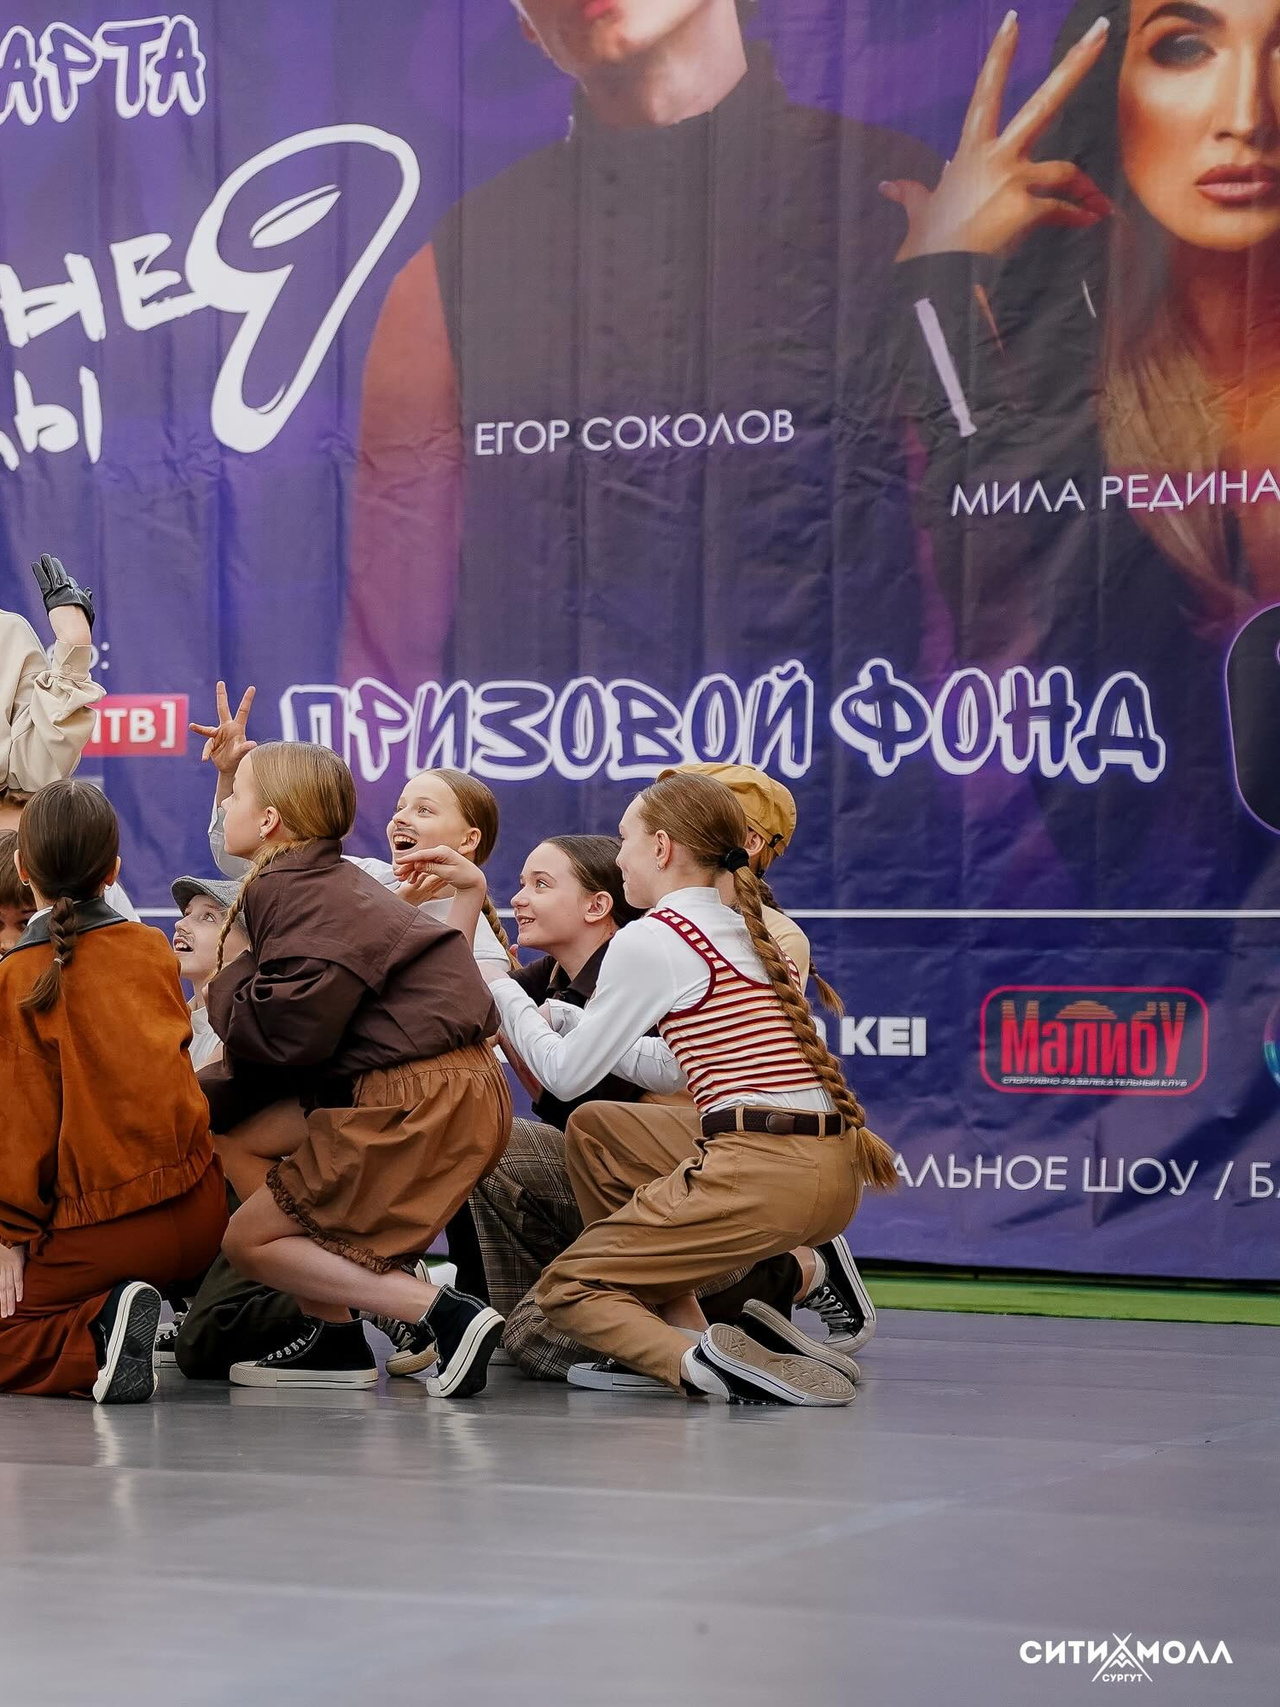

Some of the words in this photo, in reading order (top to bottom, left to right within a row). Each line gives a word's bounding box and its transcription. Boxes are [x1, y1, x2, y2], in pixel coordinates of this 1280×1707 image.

[475, 420, 570, 456] ЕГОР
[582, 409, 795, 452] СОКОЛОВ
[951, 478, 1086, 517] МИЛА
[1101, 469, 1280, 512] РЕДИНА
[280, 659, 813, 782] ПРИЗОВОЙ
[829, 657, 1166, 784] ФОНД
[841, 1016, 927, 1056] KEI
[864, 1153, 1069, 1191] АЛЬНОЕ
[1082, 1157, 1199, 1196] ШОУ
[1249, 1161, 1280, 1199] Б
